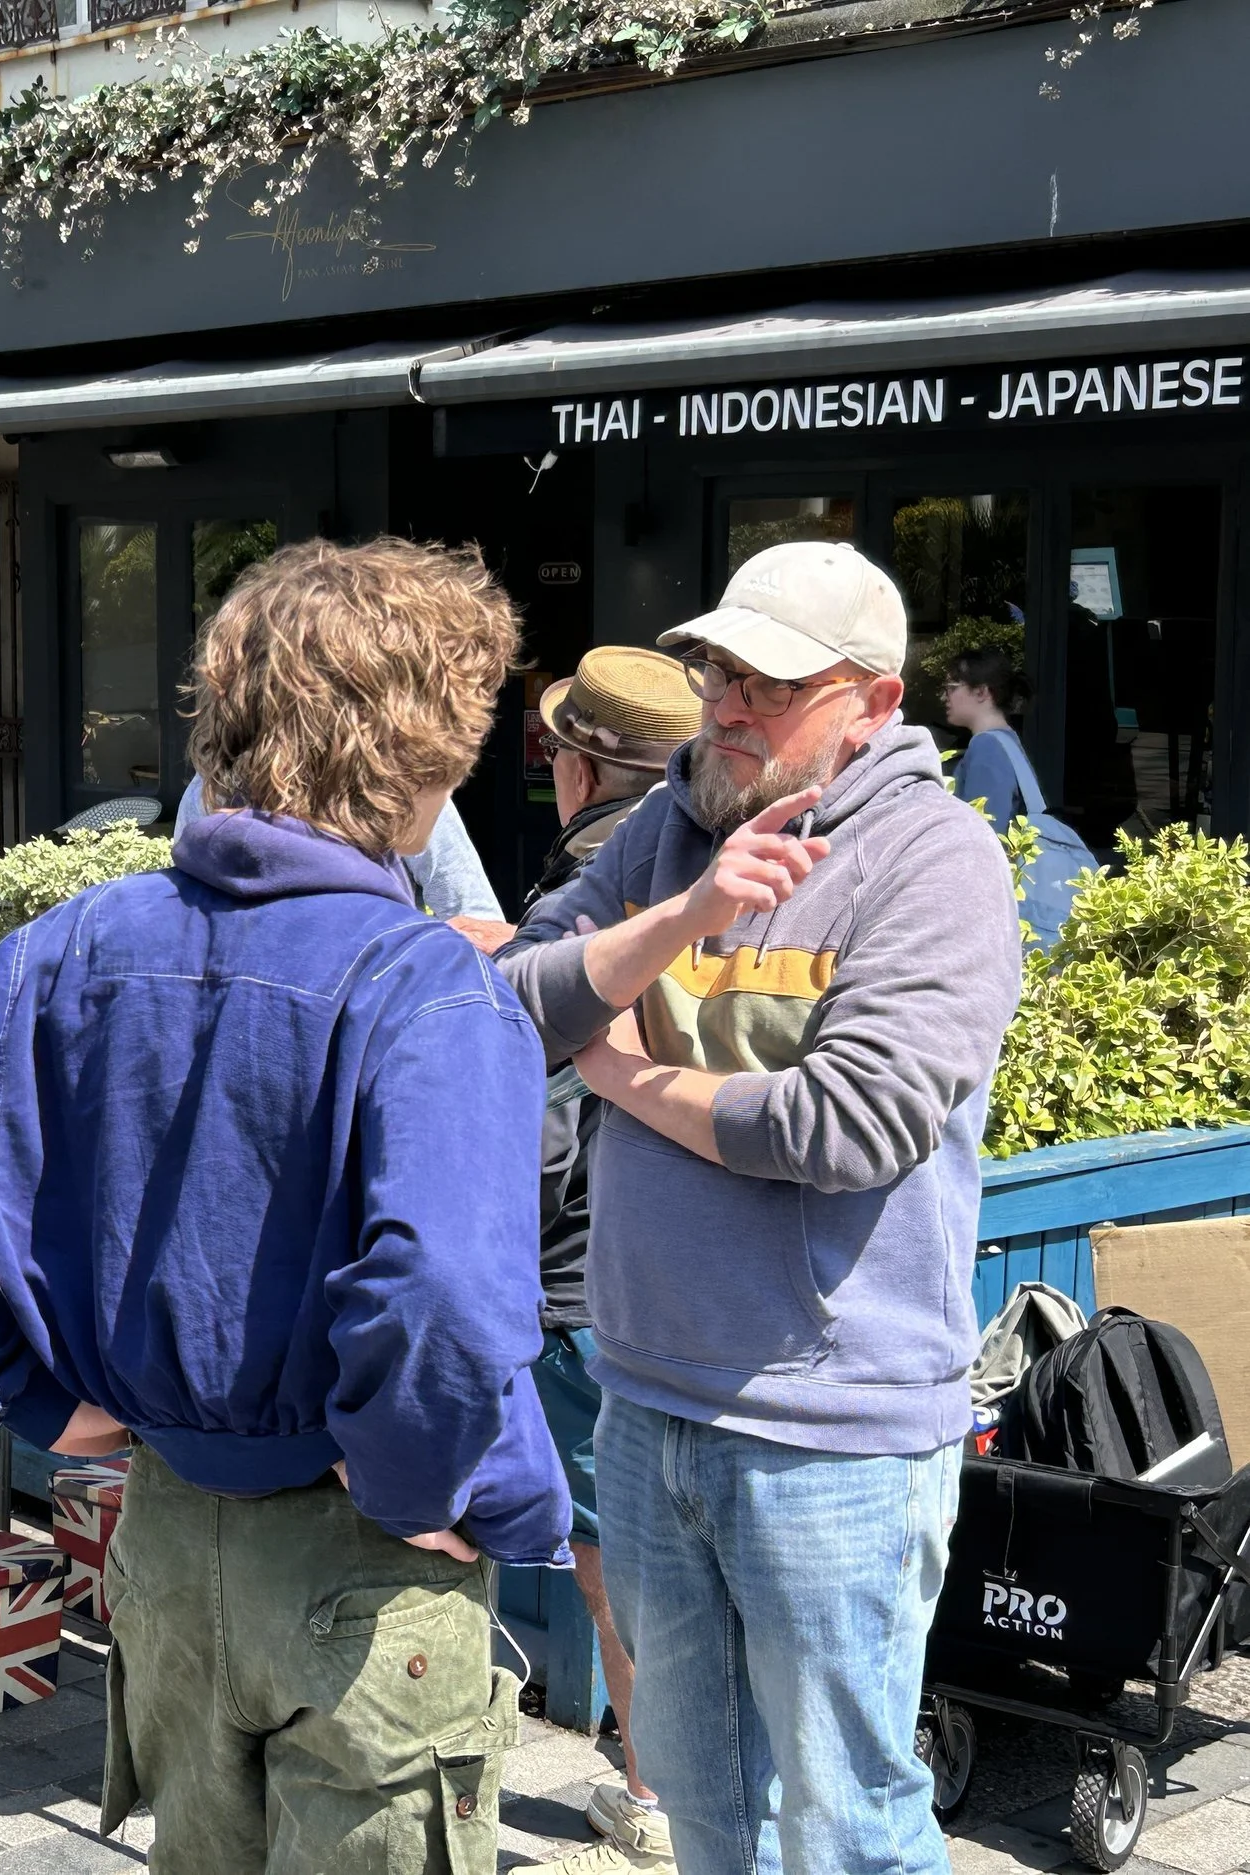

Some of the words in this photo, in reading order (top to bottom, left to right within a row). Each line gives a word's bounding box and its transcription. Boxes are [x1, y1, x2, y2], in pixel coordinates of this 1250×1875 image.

[551, 398, 641, 444] THAI
[679, 379, 944, 437] INDONESIAN
[987, 357, 1243, 420] JAPANESE
[541, 567, 578, 578] OPEN
[982, 1581, 1067, 1626] PRO
[983, 1614, 1063, 1641] ACTION
